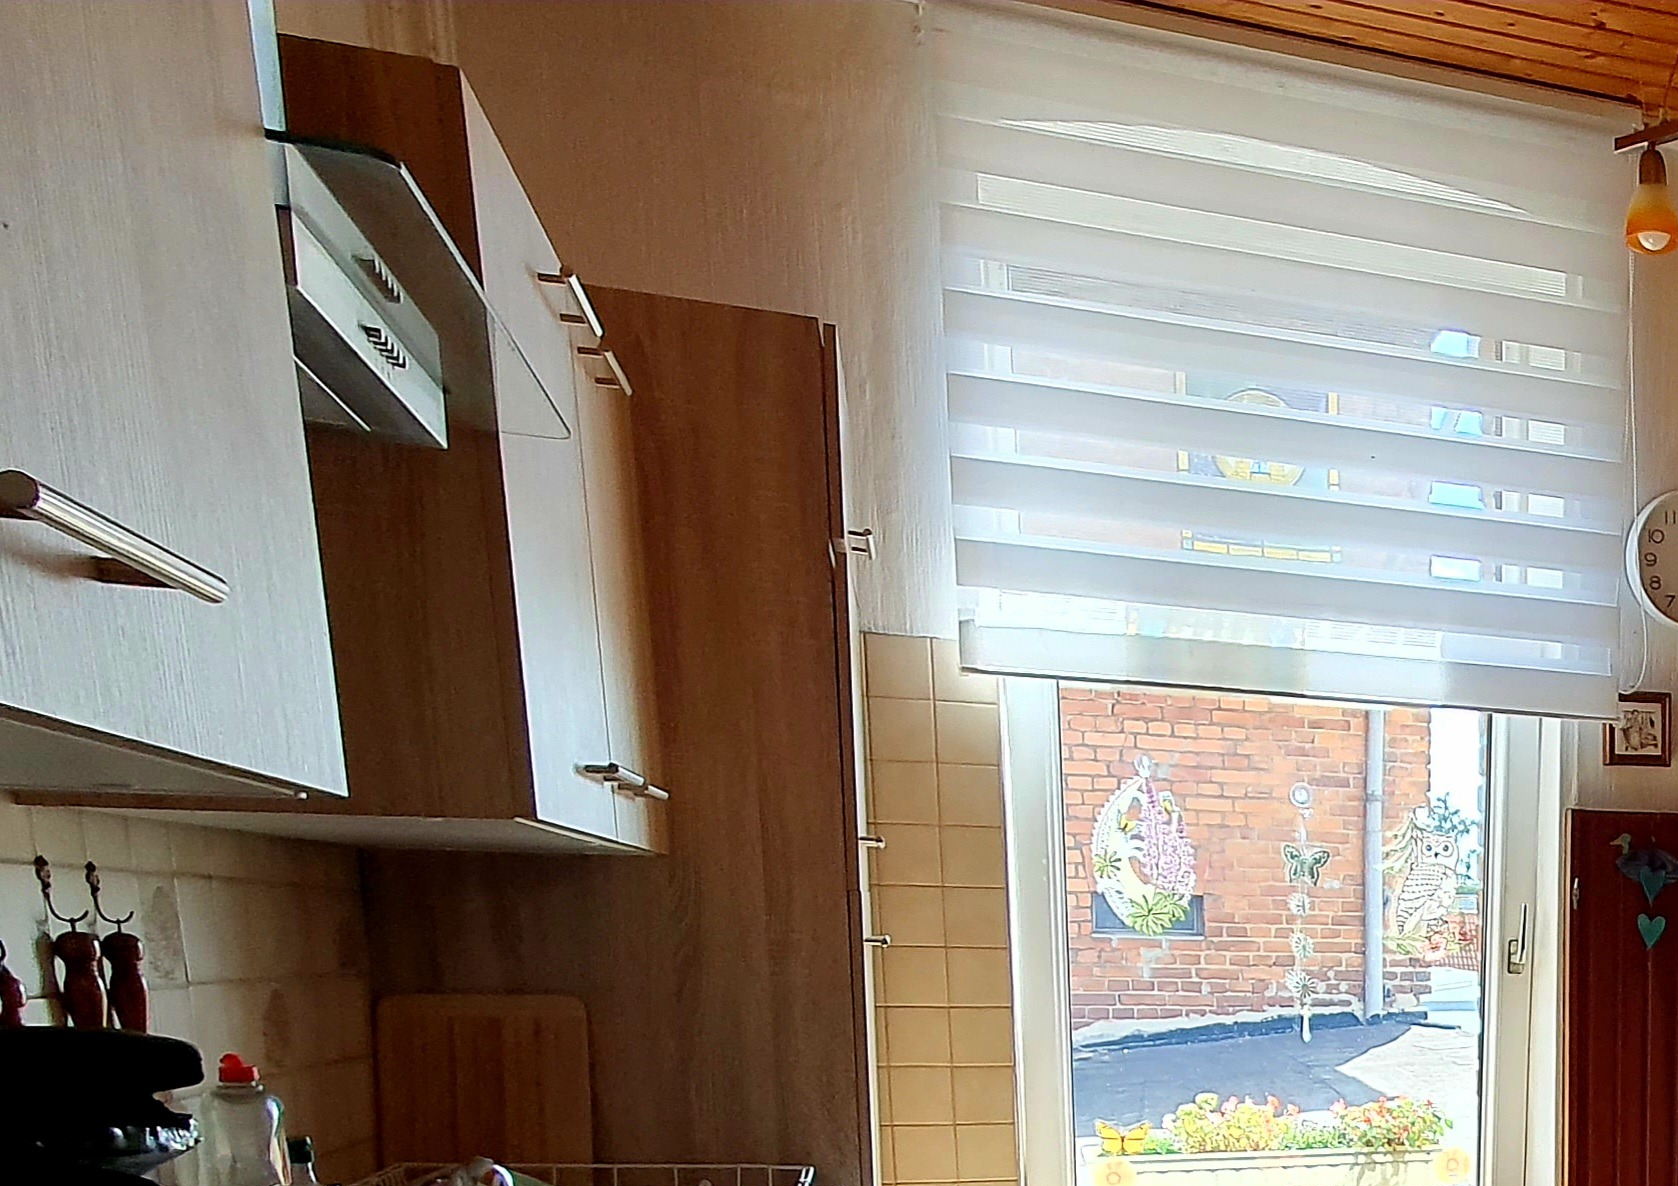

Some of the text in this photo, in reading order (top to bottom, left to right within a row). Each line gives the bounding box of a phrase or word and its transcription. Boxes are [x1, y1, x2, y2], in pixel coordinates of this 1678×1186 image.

[1665, 510, 1676, 524] 11
[1648, 529, 1665, 543] 10
[1644, 552, 1657, 566] 9
[1649, 575, 1661, 590] 8
[1664, 594, 1676, 607] 7
